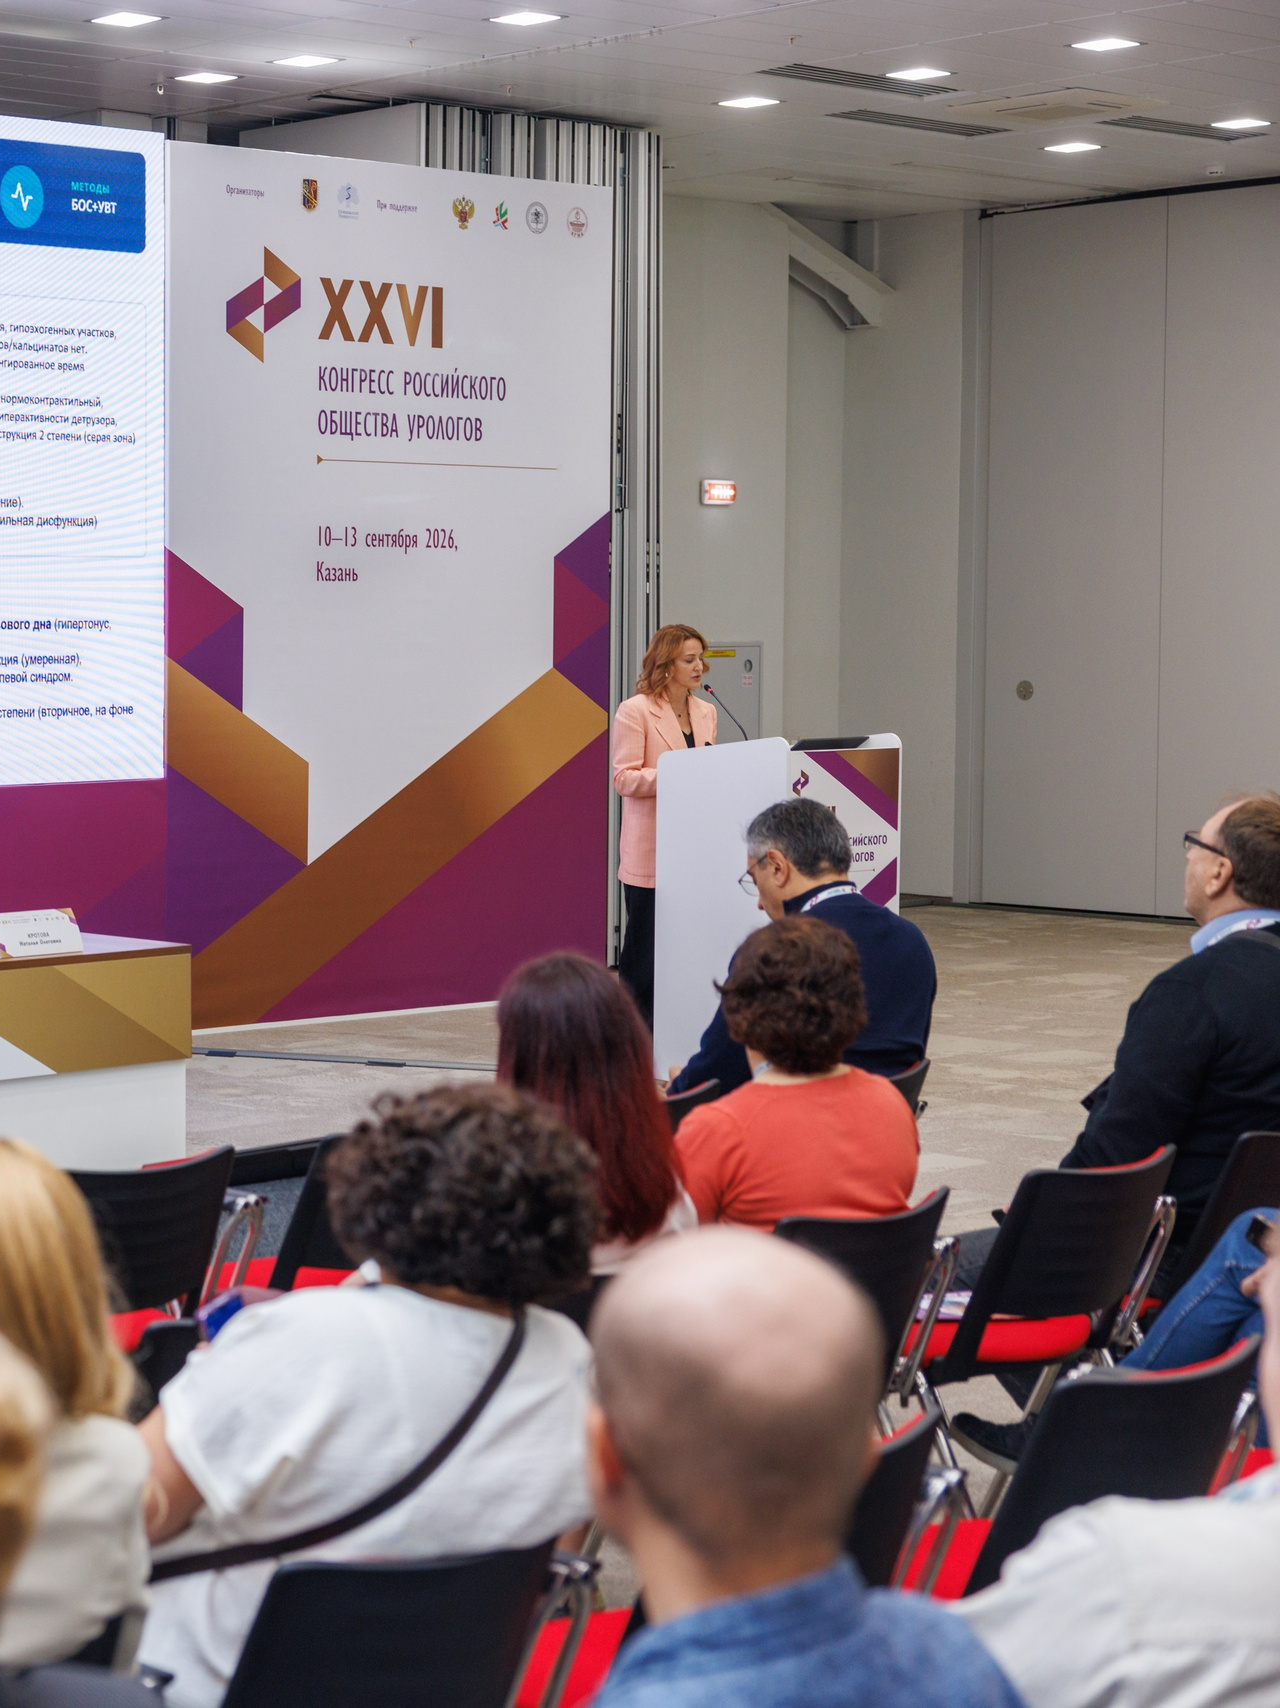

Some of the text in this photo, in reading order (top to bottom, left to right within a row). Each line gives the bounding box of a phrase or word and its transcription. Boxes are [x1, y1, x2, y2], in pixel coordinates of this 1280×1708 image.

[71, 181, 110, 195] МЕТОДЫ
[226, 184, 264, 199] Организаторы
[71, 198, 117, 214] БОС+УВТ
[377, 200, 417, 213] При поддержке
[318, 277, 443, 349] XXVI
[318, 366, 506, 401] КОНГРЕСС РОССИЙСКОГО
[318, 409, 483, 442] ОБЩЕСТВА УРОЛОГОВ
[365, 530, 418, 554] сентября
[425, 528, 458, 551] 2026,
[317, 561, 358, 583] Казань
[32, 619, 52, 632] дна
[95, 706, 107, 716] на
[108, 704, 134, 718] фоне
